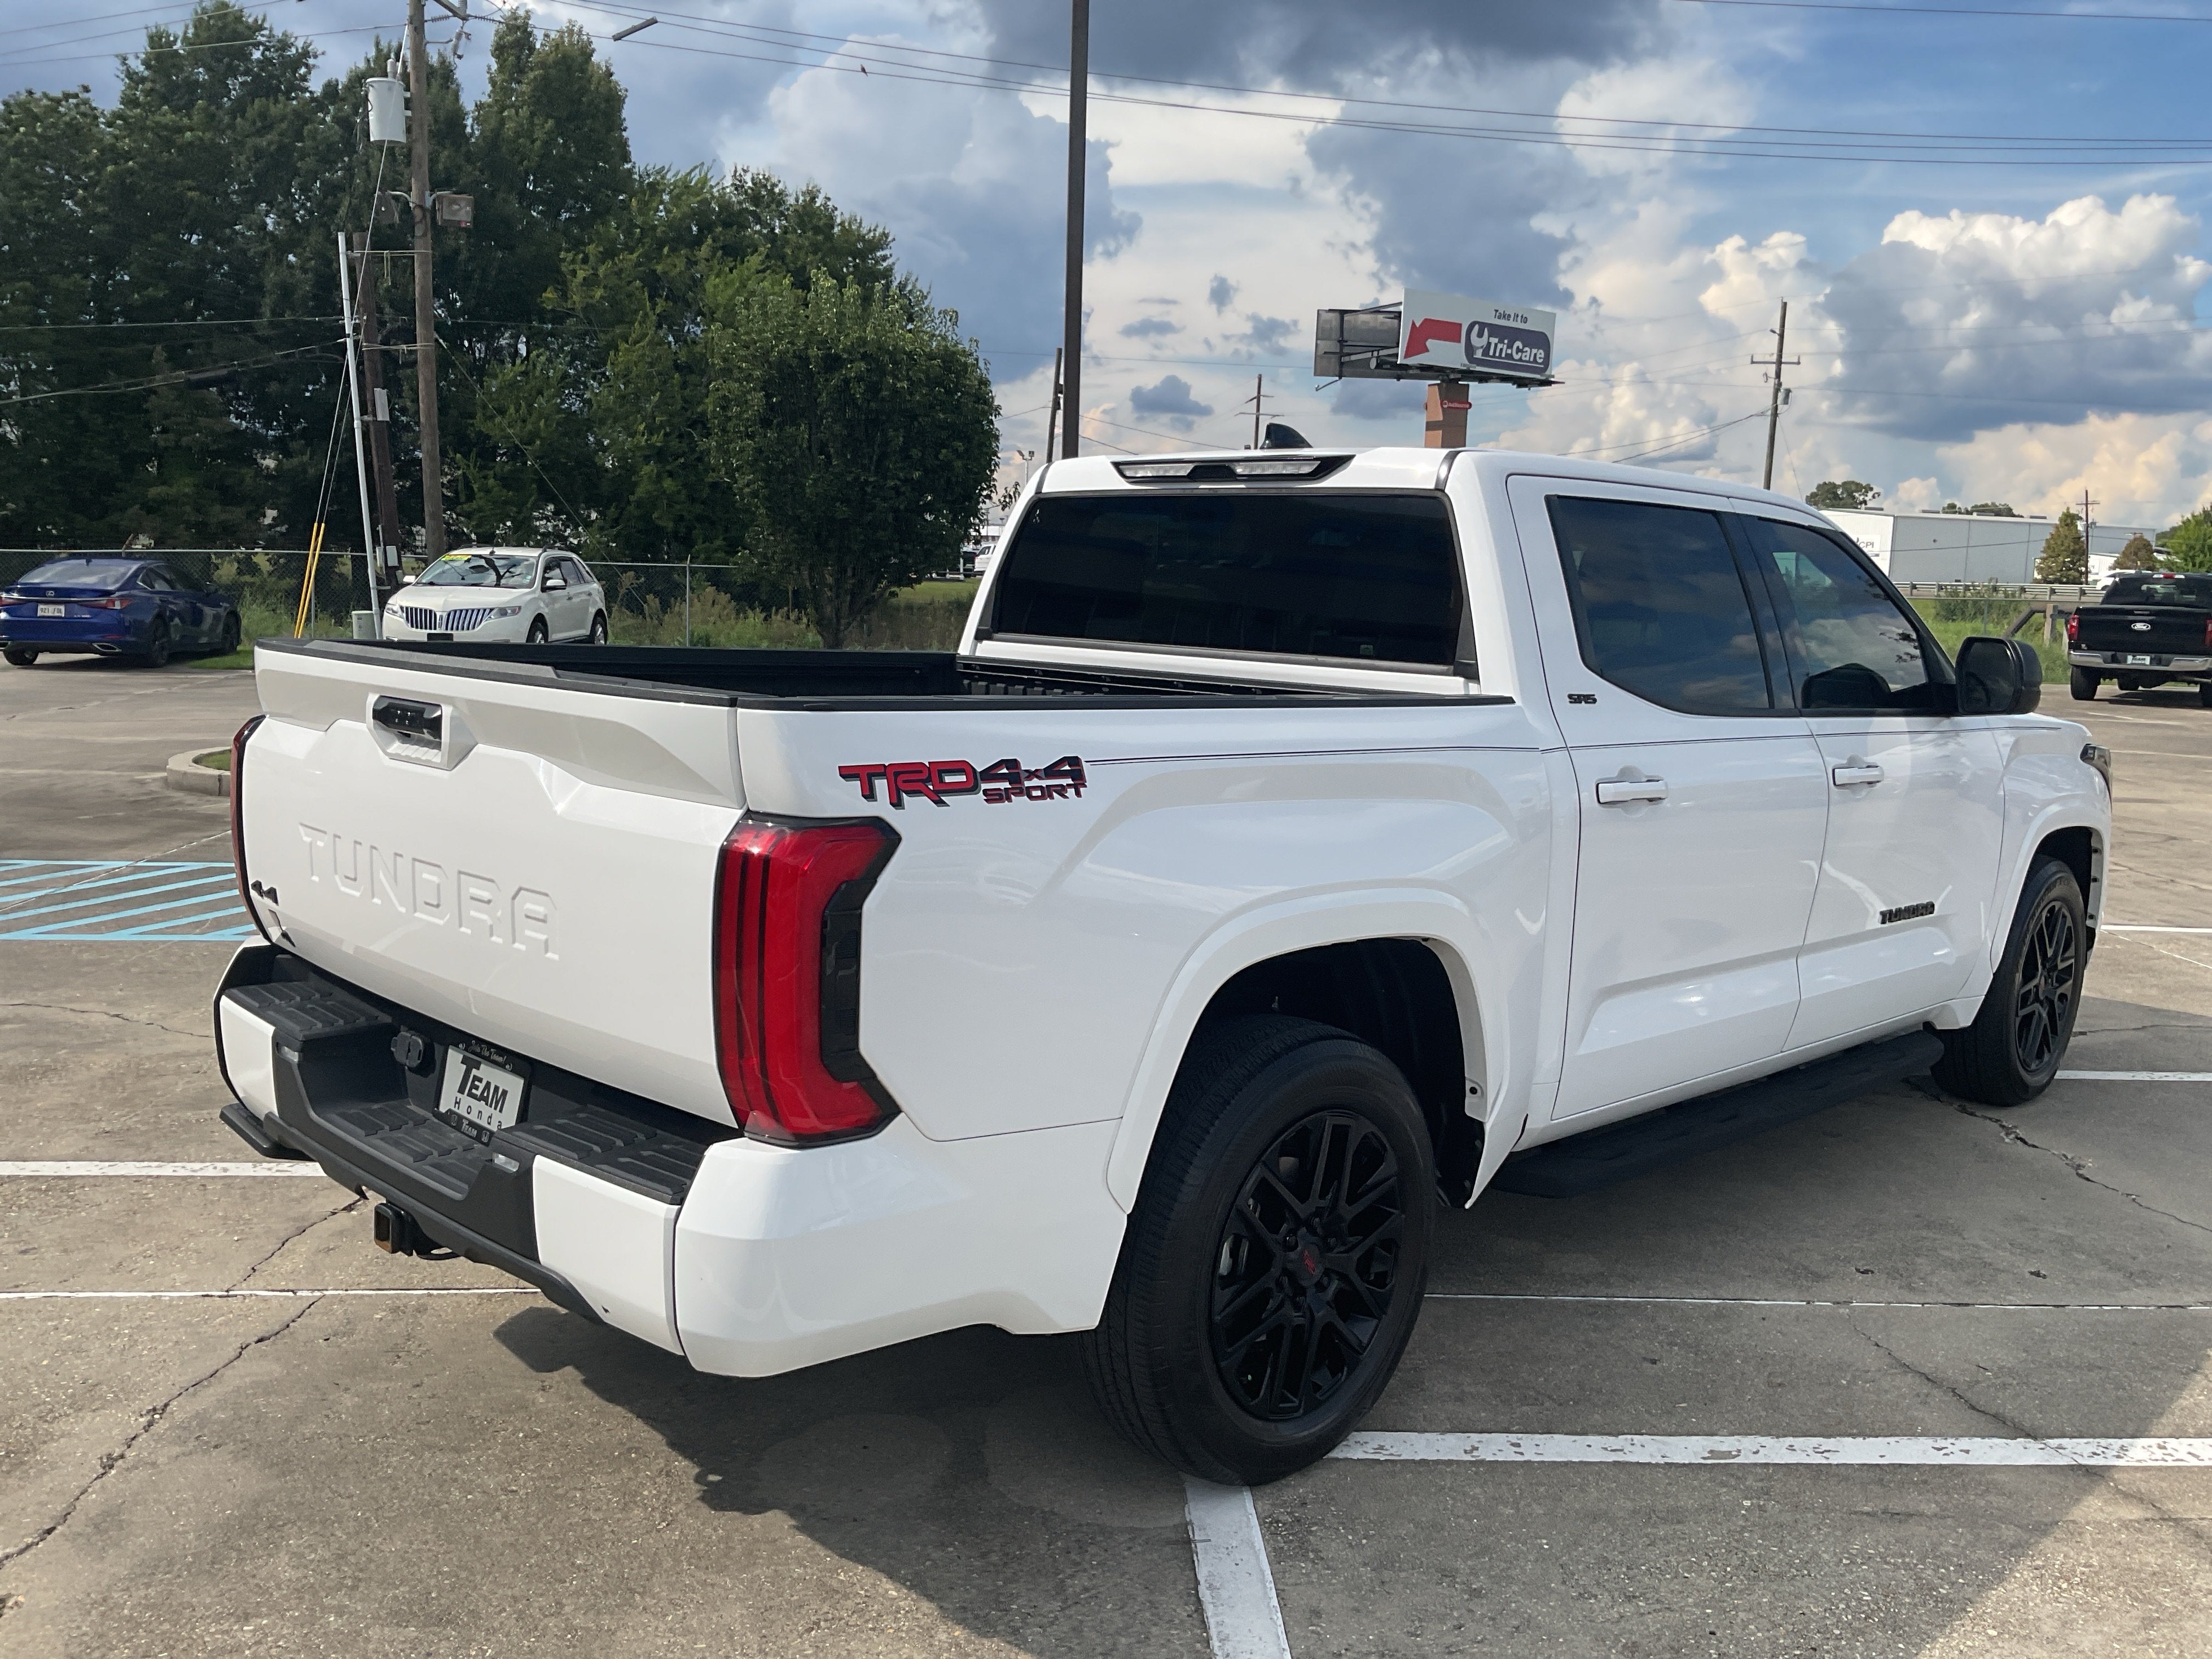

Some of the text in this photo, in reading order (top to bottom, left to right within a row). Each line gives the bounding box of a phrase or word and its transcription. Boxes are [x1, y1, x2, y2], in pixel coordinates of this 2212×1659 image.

[1494, 309, 1528, 324] Take It to
[1488, 337, 1544, 363] Tri-Care
[1567, 693, 1598, 704] SR5
[838, 755, 1087, 810] TRD 4x4
[982, 782, 1088, 804] SPORT
[298, 822, 560, 961] TUNDRA
[1879, 901, 1935, 924] TUNDRA
[454, 1096, 503, 1130] Honda
